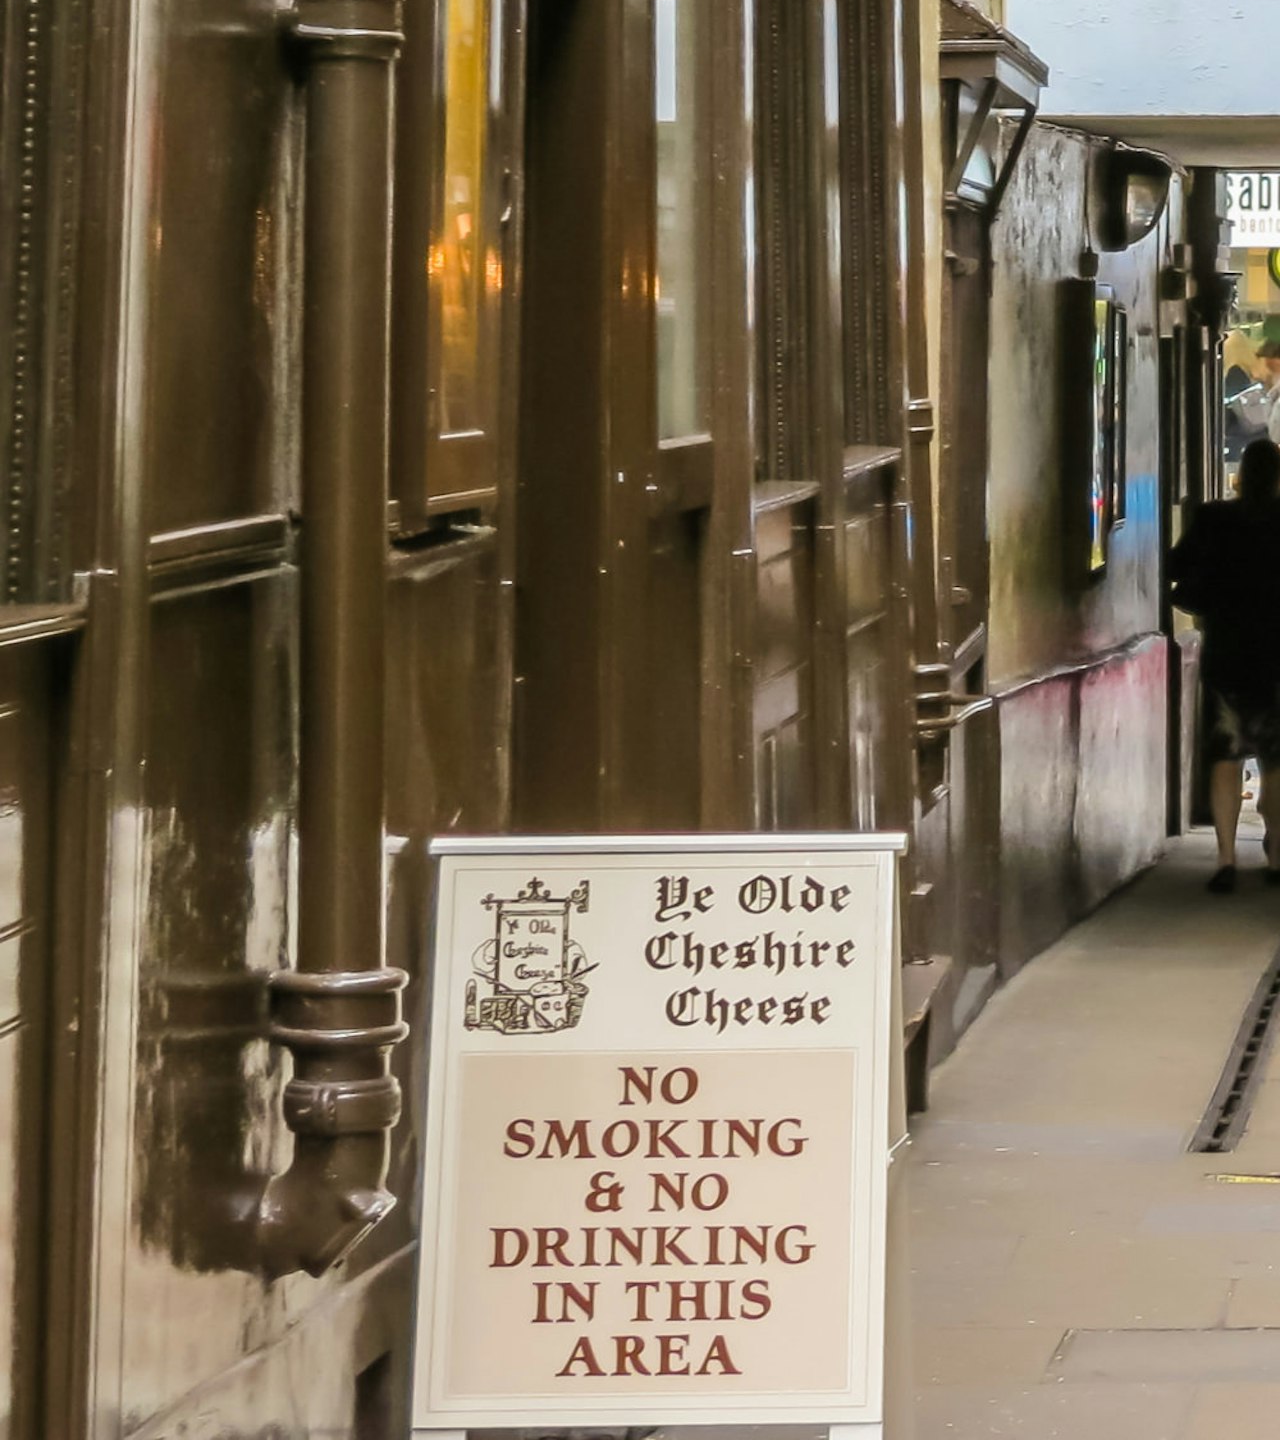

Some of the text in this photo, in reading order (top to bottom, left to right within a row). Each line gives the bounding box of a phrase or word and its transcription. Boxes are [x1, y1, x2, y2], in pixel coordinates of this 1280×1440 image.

[655, 874, 852, 923] Ye Olde
[645, 930, 856, 976] Cheshire
[665, 986, 833, 1035] Cheese
[618, 1066, 699, 1106] NO
[503, 1118, 809, 1159] SMOKING
[584, 1170, 729, 1213] & NO
[488, 1224, 817, 1268] DRINKING
[531, 1279, 772, 1324] IN THIS
[555, 1334, 742, 1378] AREA
